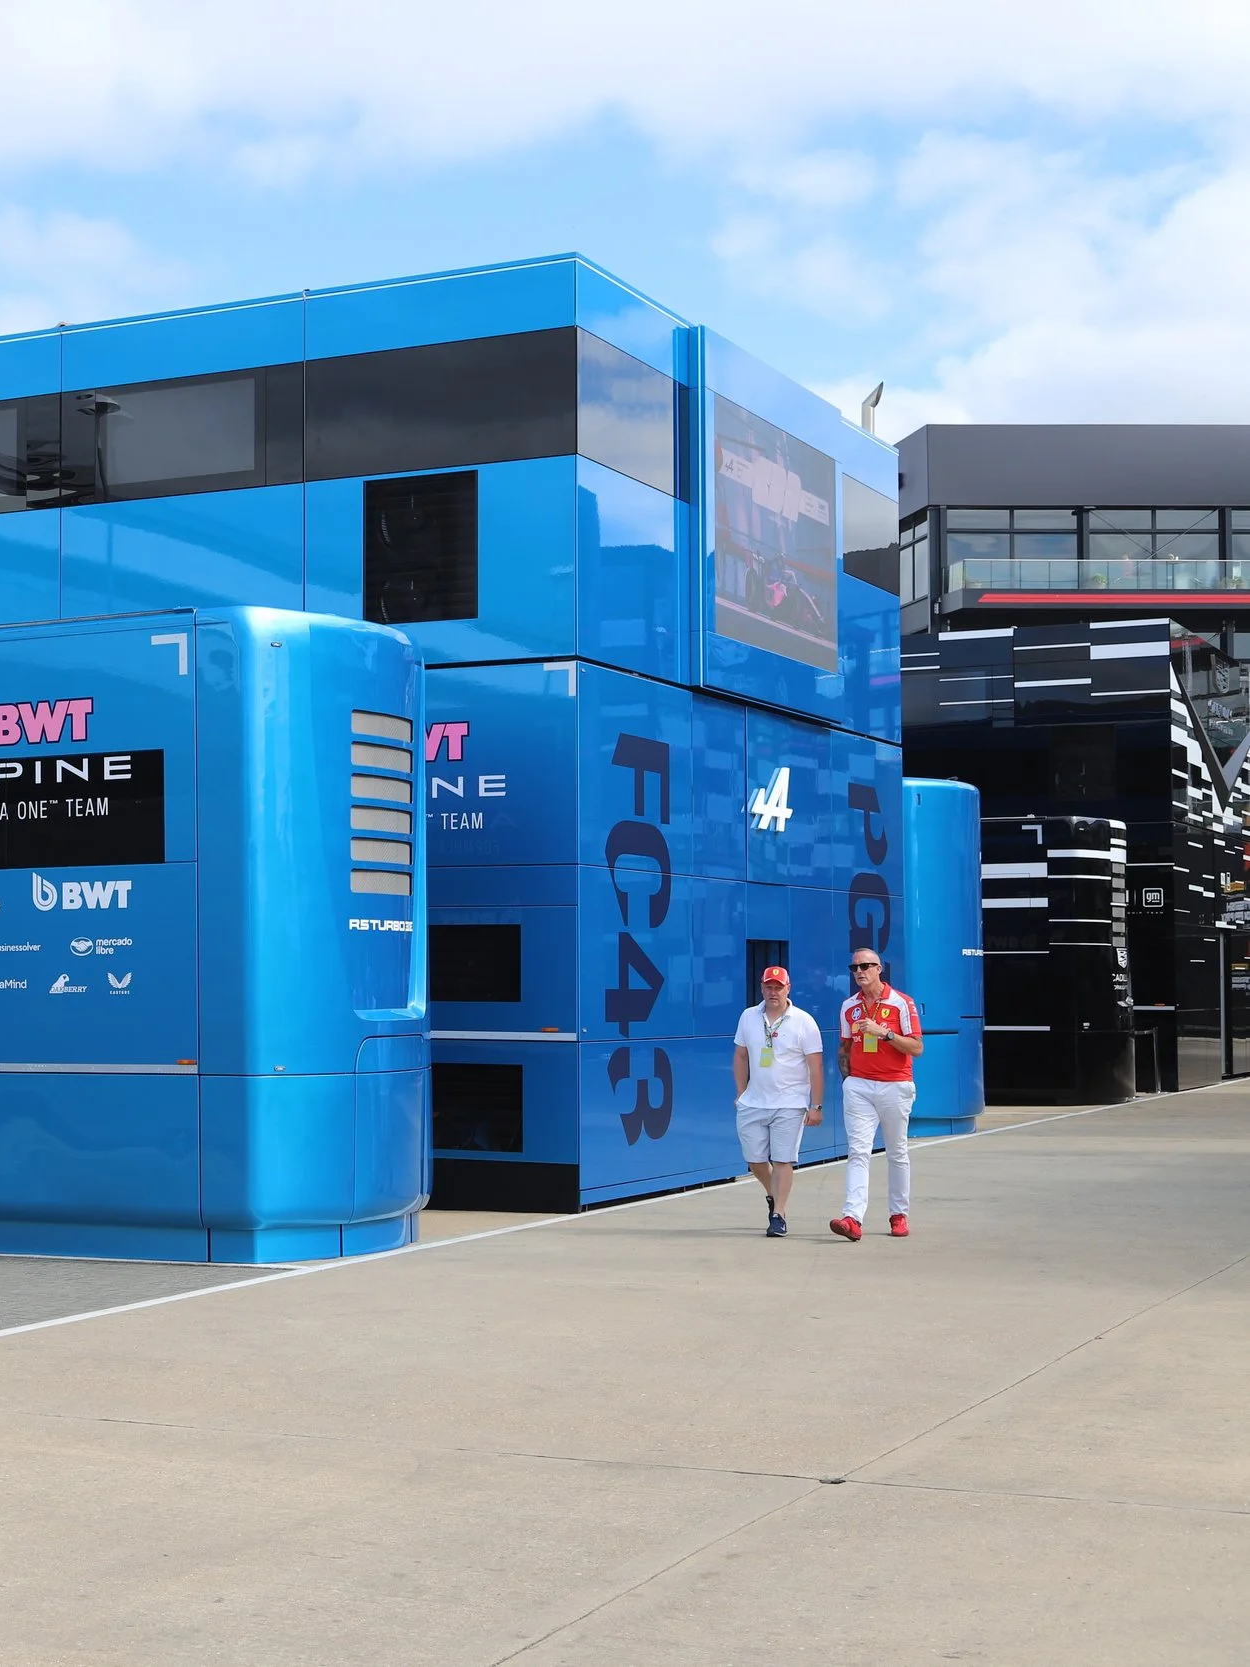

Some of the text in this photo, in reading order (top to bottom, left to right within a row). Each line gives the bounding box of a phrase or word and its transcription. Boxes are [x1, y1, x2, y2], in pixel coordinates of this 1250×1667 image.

[66, 797, 109, 817] TEAM
[441, 812, 483, 830] TEAM
[62, 880, 132, 910] BWT
[1146, 892, 1160, 903] gm
[95, 937, 133, 946] mercado
[605, 733, 673, 1146] FC43
[95, 946, 114, 955] libre
